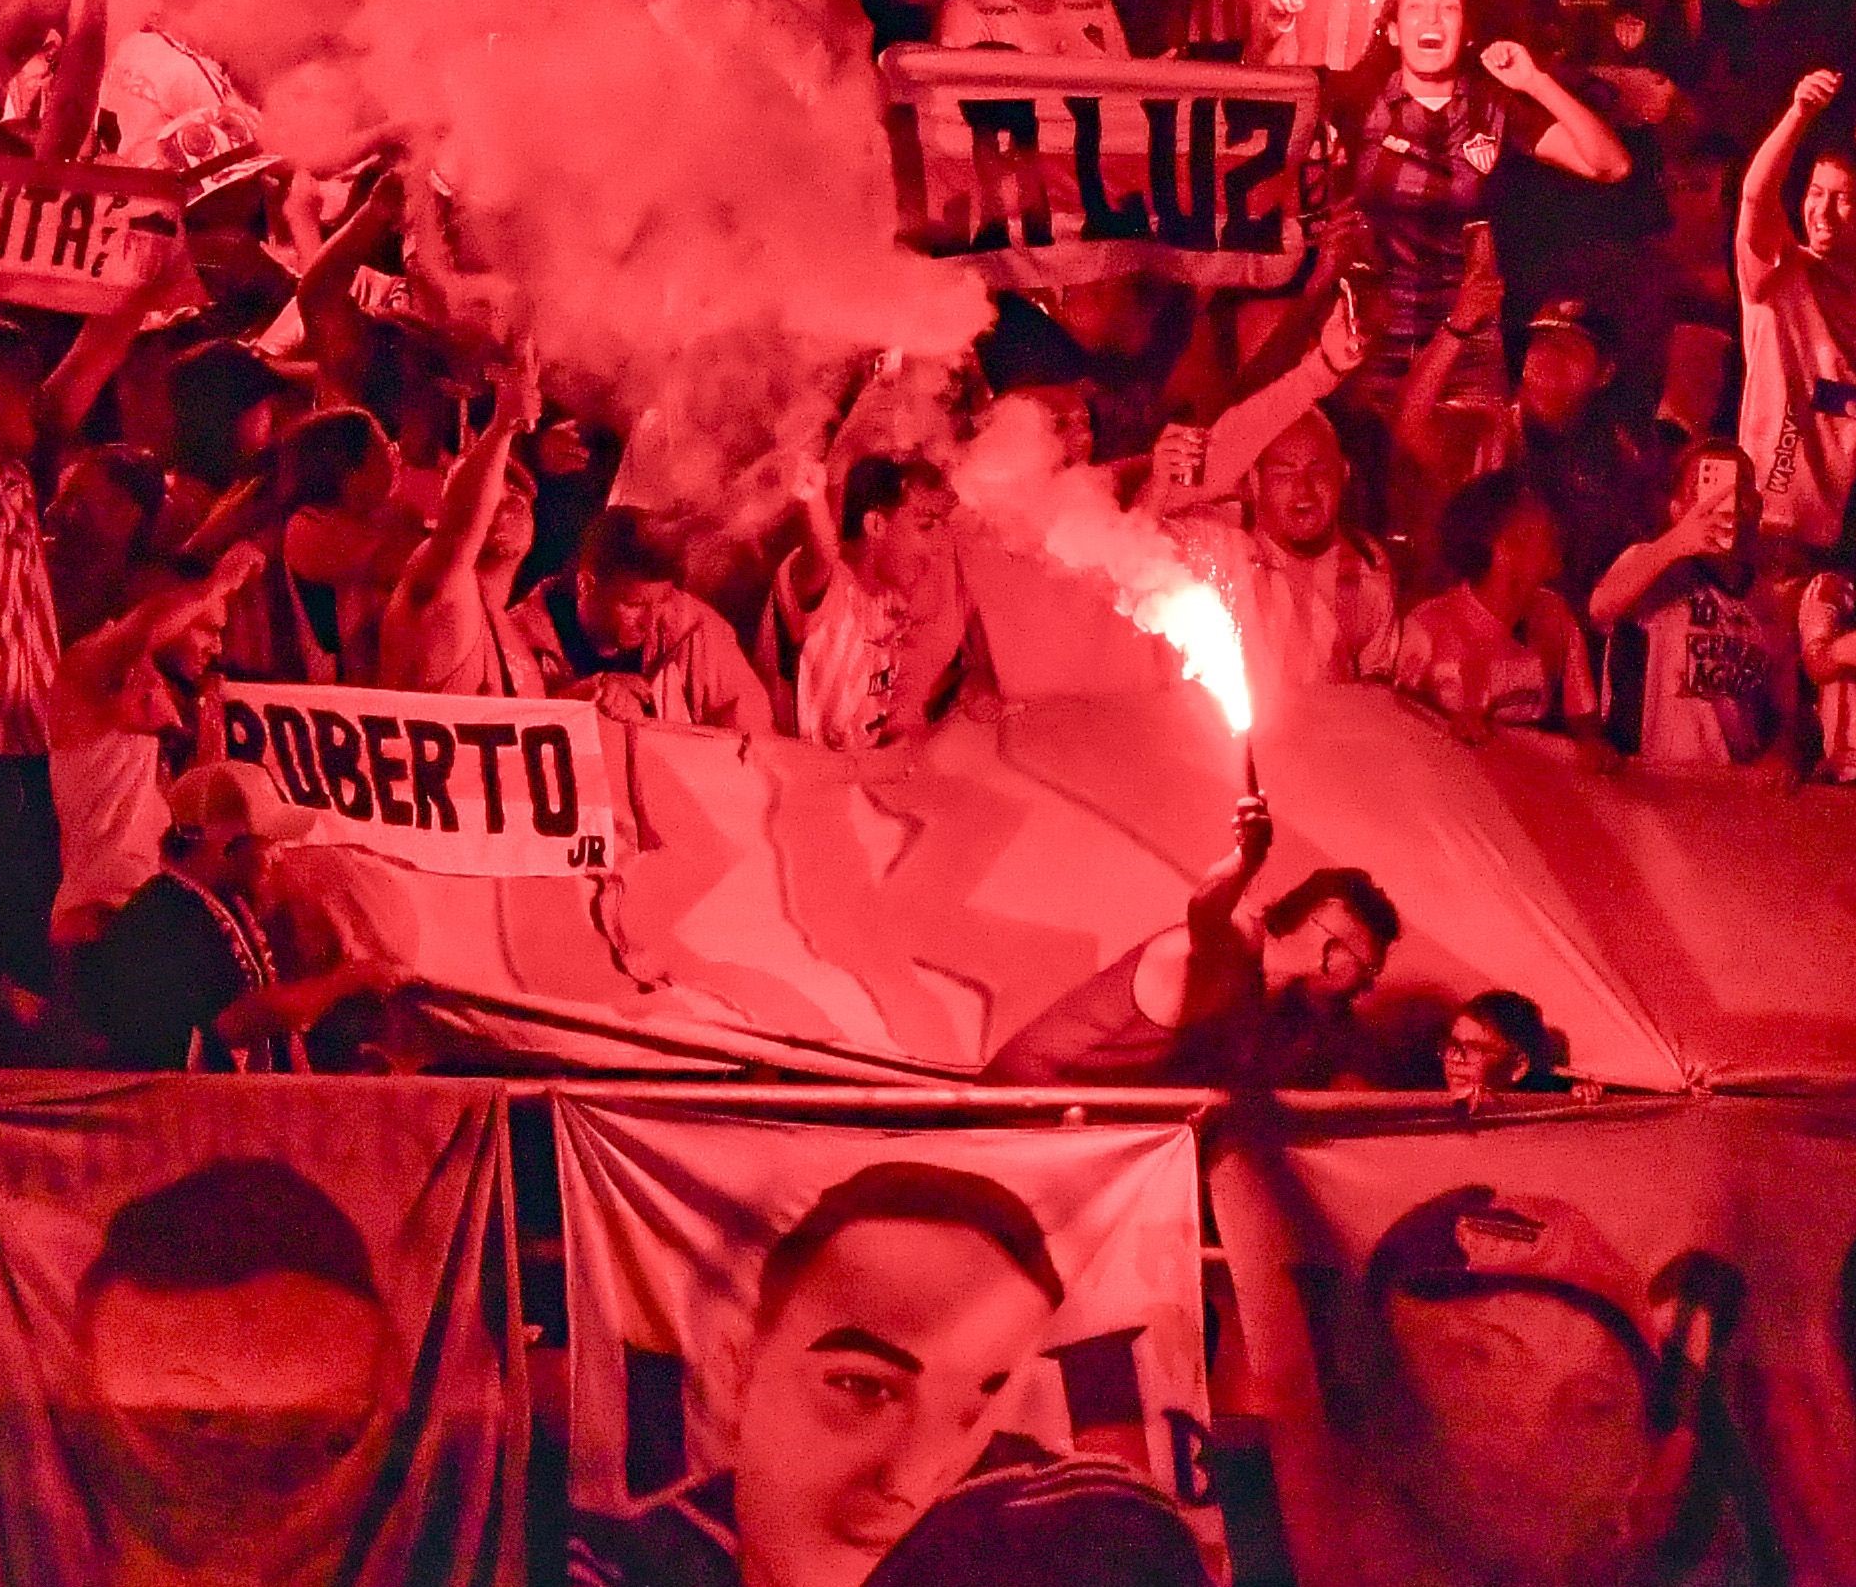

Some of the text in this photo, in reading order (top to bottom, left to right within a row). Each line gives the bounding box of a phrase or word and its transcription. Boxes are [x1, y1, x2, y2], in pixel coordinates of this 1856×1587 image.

[893, 97, 1299, 258] LA LUZ
[223, 700, 579, 837] ROBERTO
[566, 835, 607, 868] JR
